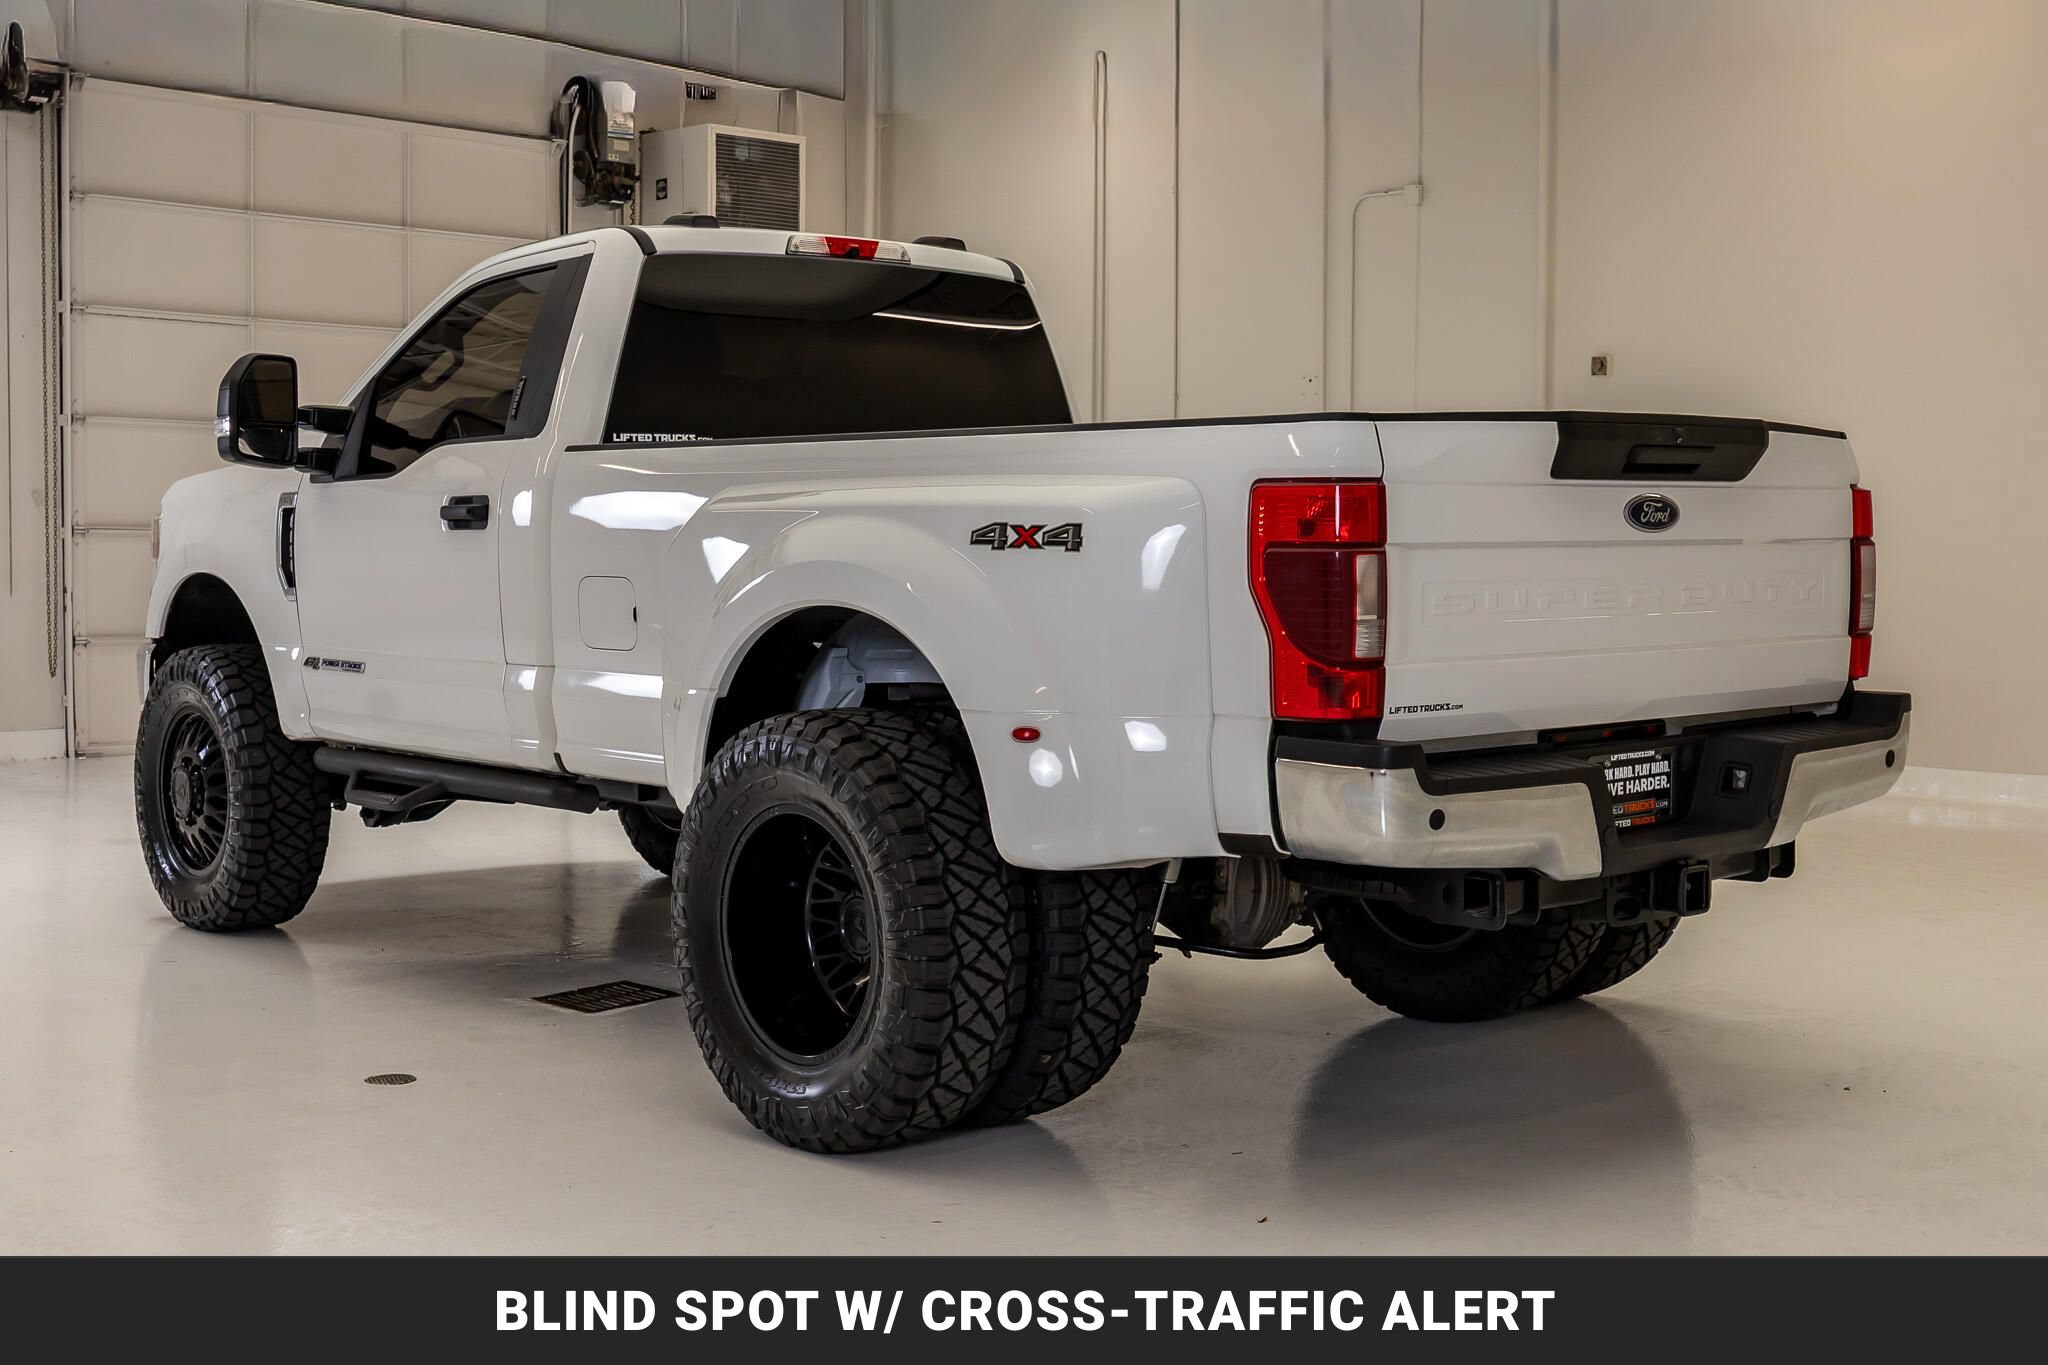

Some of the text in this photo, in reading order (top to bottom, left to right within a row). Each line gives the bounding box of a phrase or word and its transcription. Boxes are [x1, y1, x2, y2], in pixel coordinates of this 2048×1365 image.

[613, 433, 713, 442] LIFTED TRUCKSCOM
[1641, 501, 1671, 523] Ford
[1431, 574, 1821, 617] SUPER DUTY
[1389, 705, 1418, 715] LIFTED
[1610, 753, 1627, 761] LIFTED
[1614, 765, 1635, 780] HARD.
[1635, 763, 1651, 777] PLAY
[1651, 760, 1671, 774] HARD.
[1626, 775, 1670, 795] HARDER.
